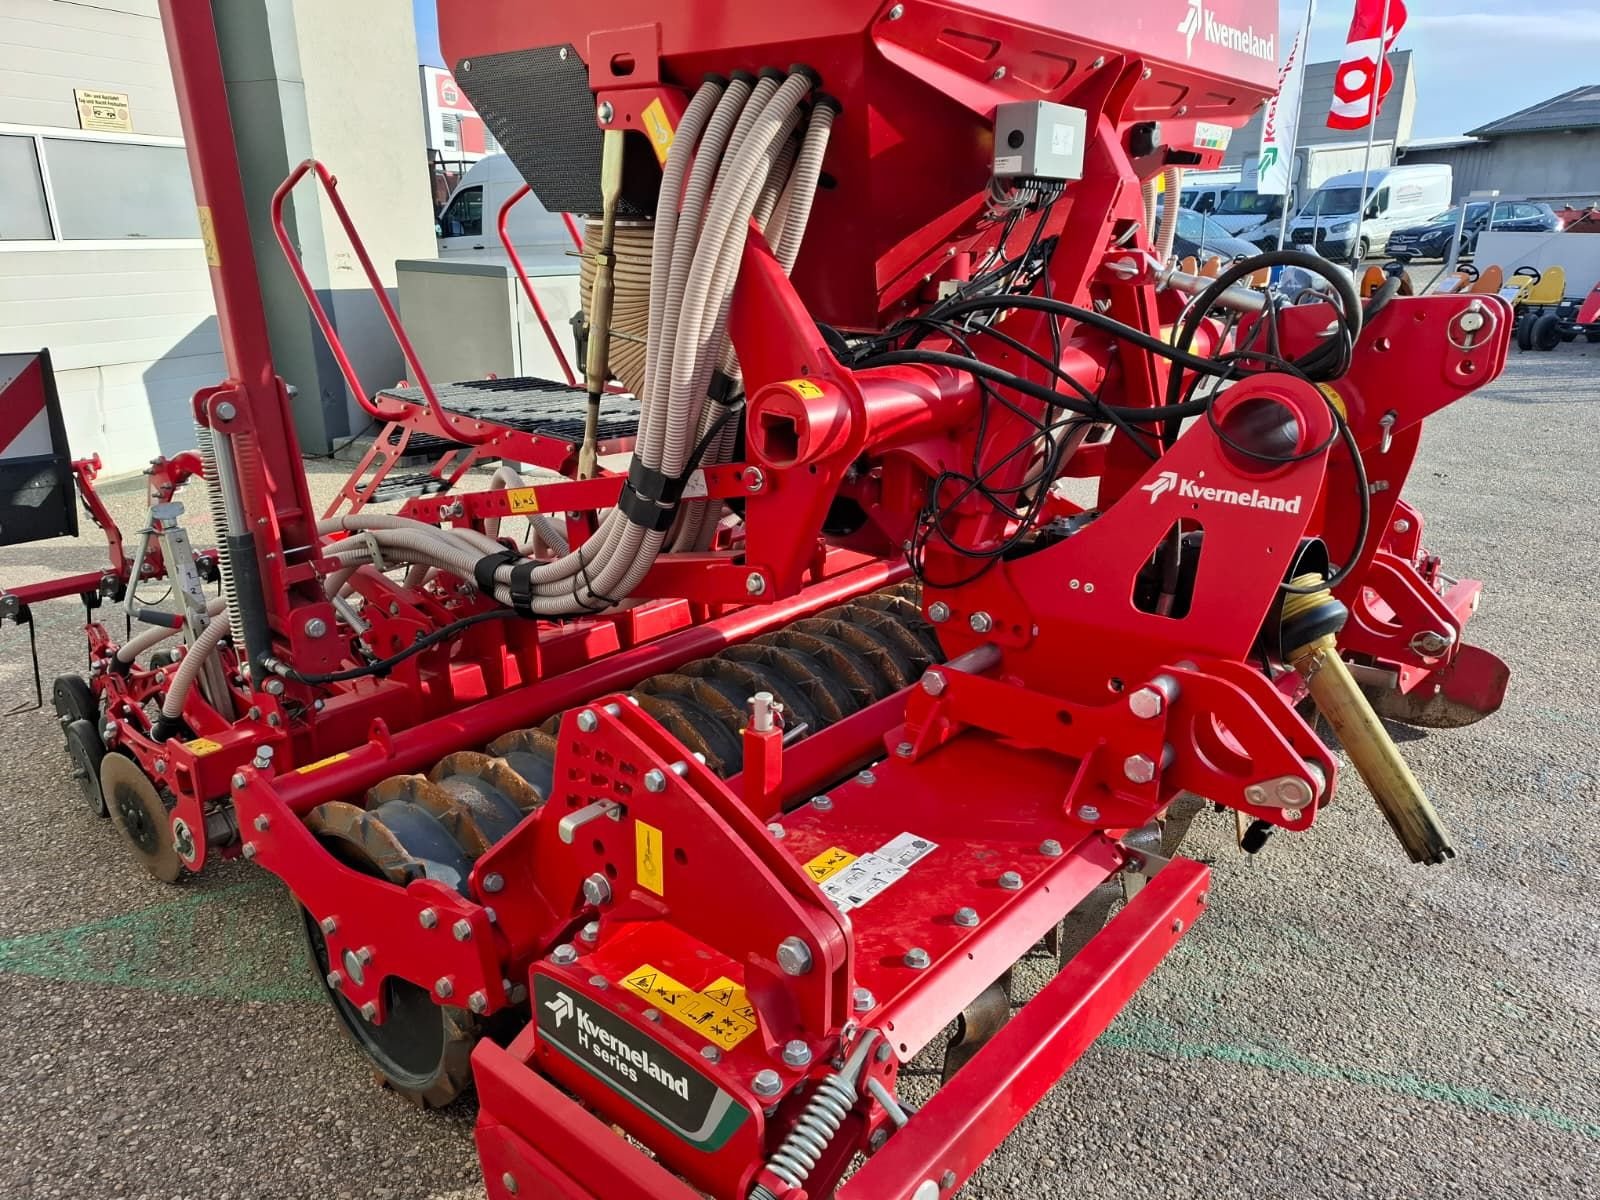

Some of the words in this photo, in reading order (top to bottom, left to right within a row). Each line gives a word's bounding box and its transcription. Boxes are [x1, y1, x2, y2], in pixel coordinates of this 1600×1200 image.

[1204, 9, 1274, 61] Kverneland
[1178, 478, 1302, 514] Kverneland
[576, 1007, 689, 1101] Kverneland
[578, 1029, 589, 1050] H
[593, 1045, 638, 1083] series
